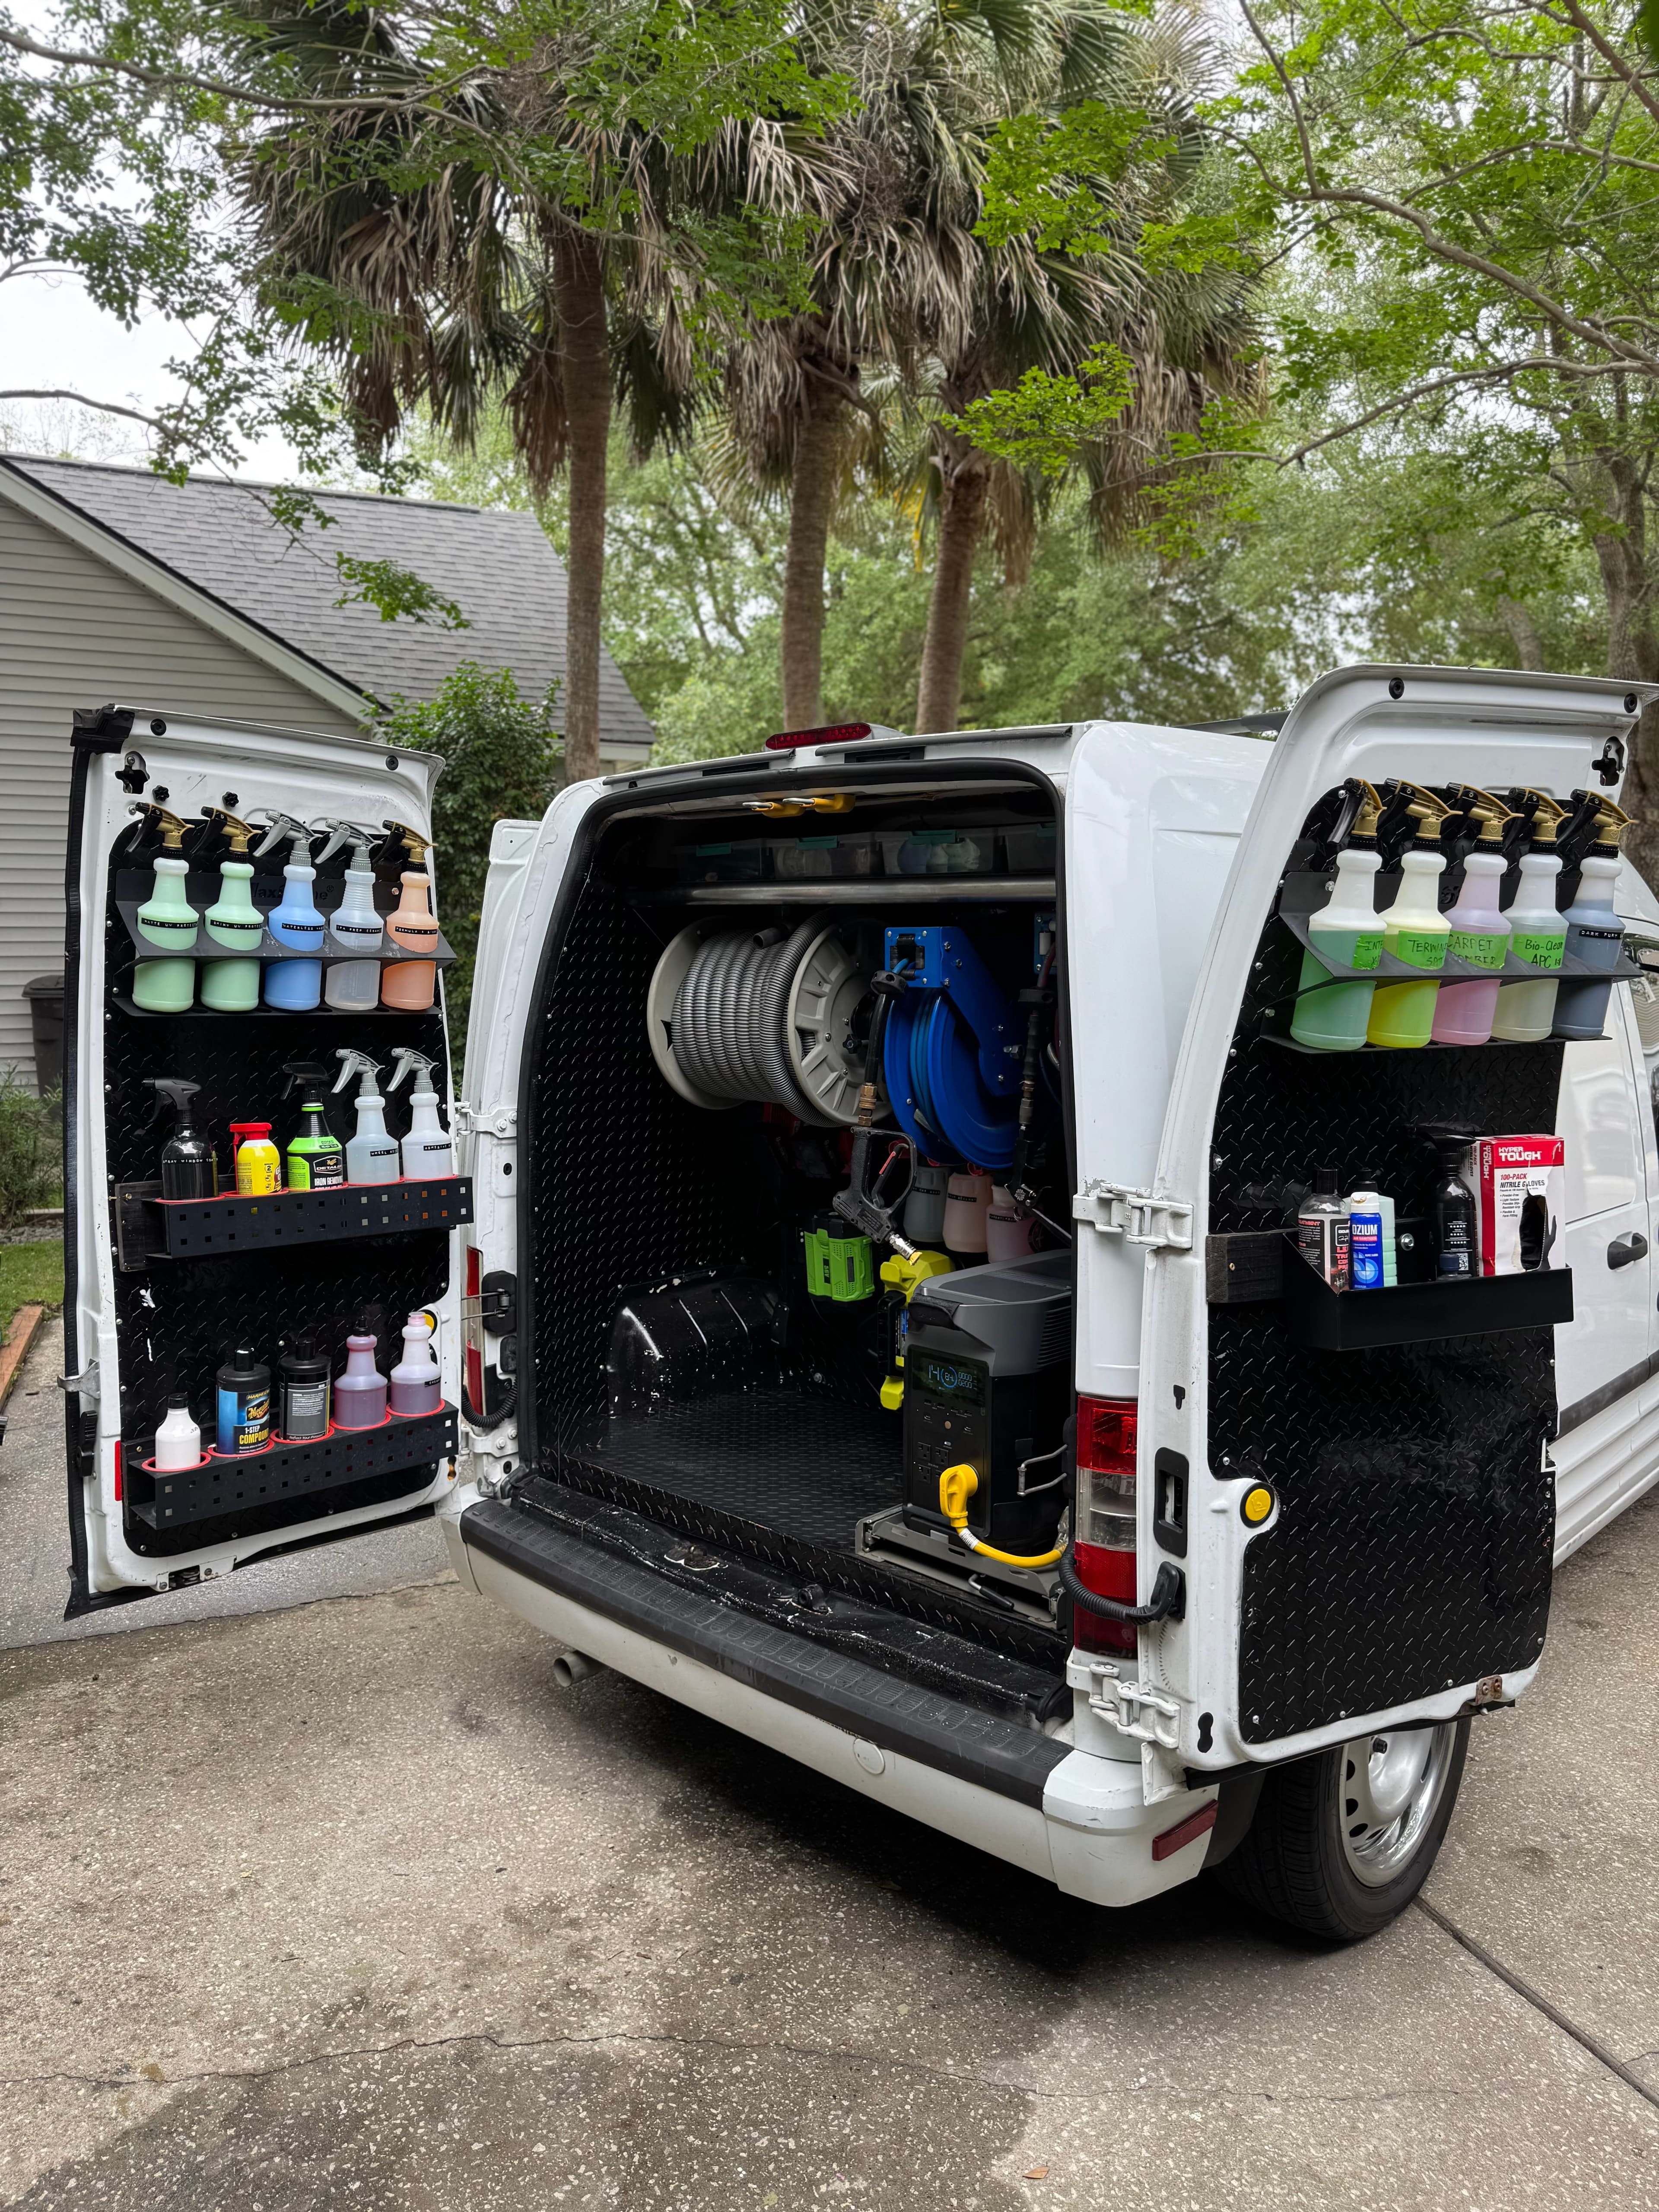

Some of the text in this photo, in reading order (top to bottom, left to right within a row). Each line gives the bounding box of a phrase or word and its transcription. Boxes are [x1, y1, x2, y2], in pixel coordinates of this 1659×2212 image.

[1525, 939, 1563, 950] Bio-Clean
[1531, 953, 1552, 969] APC
[1499, 1151, 1542, 1162] TOUGH
[315, 1178, 326, 1186] IRON
[1352, 1224, 1377, 1235] OZIUM
[245, 1425, 260, 1434] 1-STEP
[239, 1428, 269, 1444] COMPOUN
